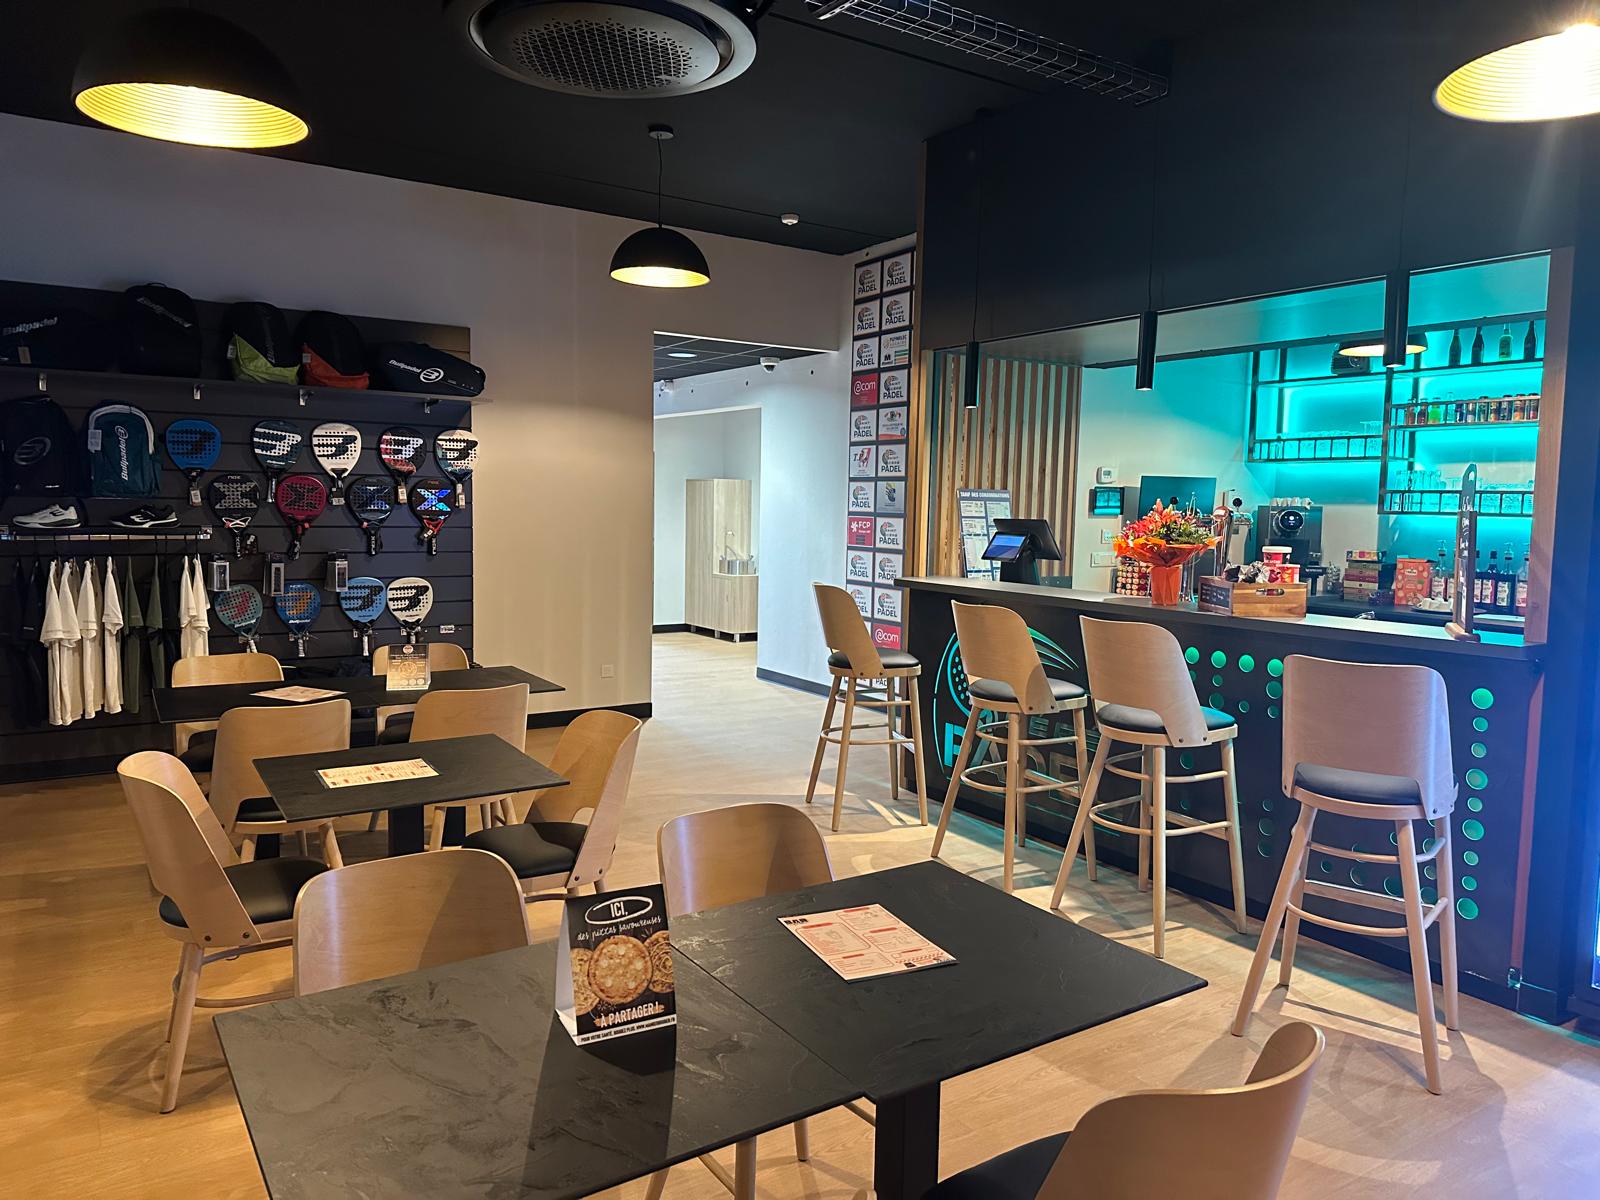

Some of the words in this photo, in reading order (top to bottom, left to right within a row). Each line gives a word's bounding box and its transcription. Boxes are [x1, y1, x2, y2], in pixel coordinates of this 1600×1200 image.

[886, 276, 907, 288] PADEL
[857, 283, 877, 295] PADEL
[885, 315, 905, 326] PADEL
[857, 322, 876, 331] PADEL
[855, 358, 875, 367] PADEL
[883, 391, 904, 399] PADEL
[853, 430, 873, 438] PADEL
[118, 437, 129, 481] Bullpadel
[881, 465, 901, 473] PADEL
[879, 536, 900, 545] PADEL
[850, 569, 869, 578] PADEL
[877, 608, 897, 617] PADEL
[875, 628, 899, 642] @com
[592, 926, 616, 941] pizzas
[618, 915, 662, 932] savoureuses
[601, 1013, 607, 1028] À
[608, 1002, 654, 1026] PARTAGER
